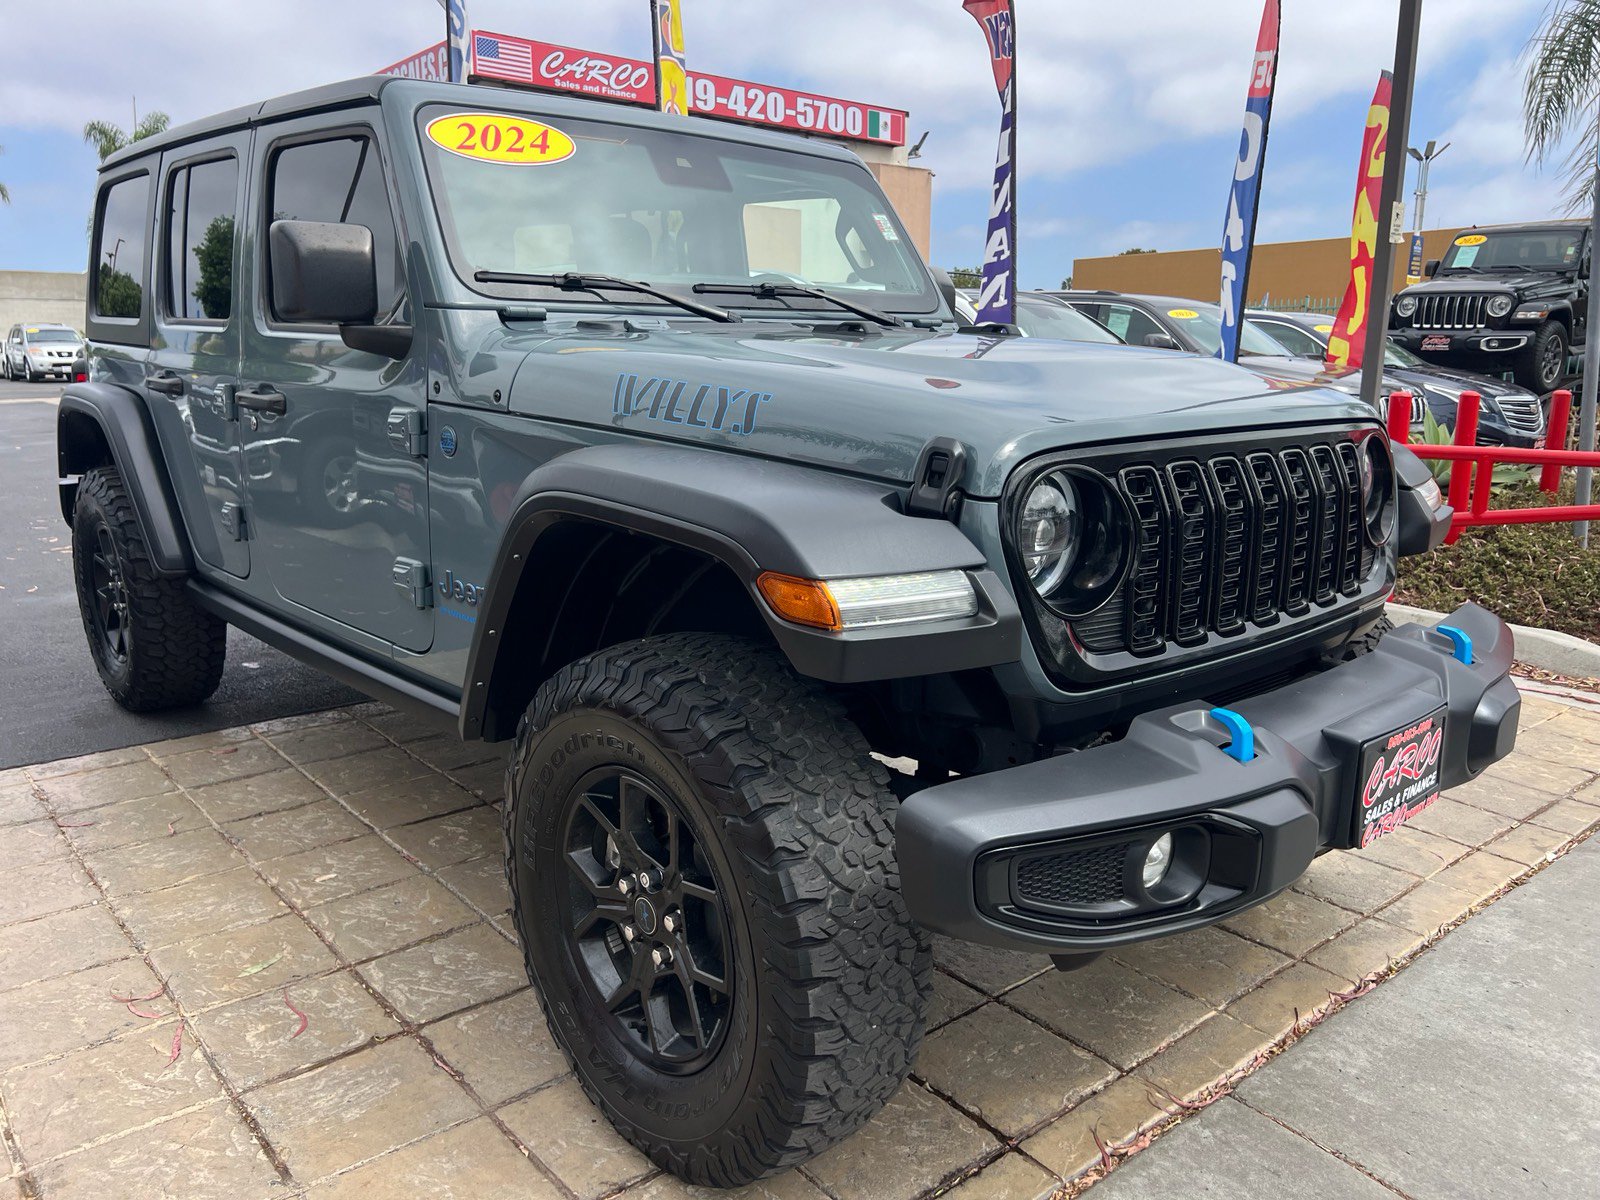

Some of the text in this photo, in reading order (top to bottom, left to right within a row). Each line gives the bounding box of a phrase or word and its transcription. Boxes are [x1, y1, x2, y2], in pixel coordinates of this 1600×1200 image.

[540, 51, 649, 90] CARCO
[554, 78, 637, 99] Sales and Finance
[687, 76, 862, 136] 19-420-5700
[456, 122, 550, 154] 2024
[612, 373, 774, 435] WILLYS
[1363, 727, 1442, 808] CARCO
[1364, 798, 1394, 824] SALES
[1394, 792, 1400, 807] &
[1402, 771, 1437, 802] FINANCE
